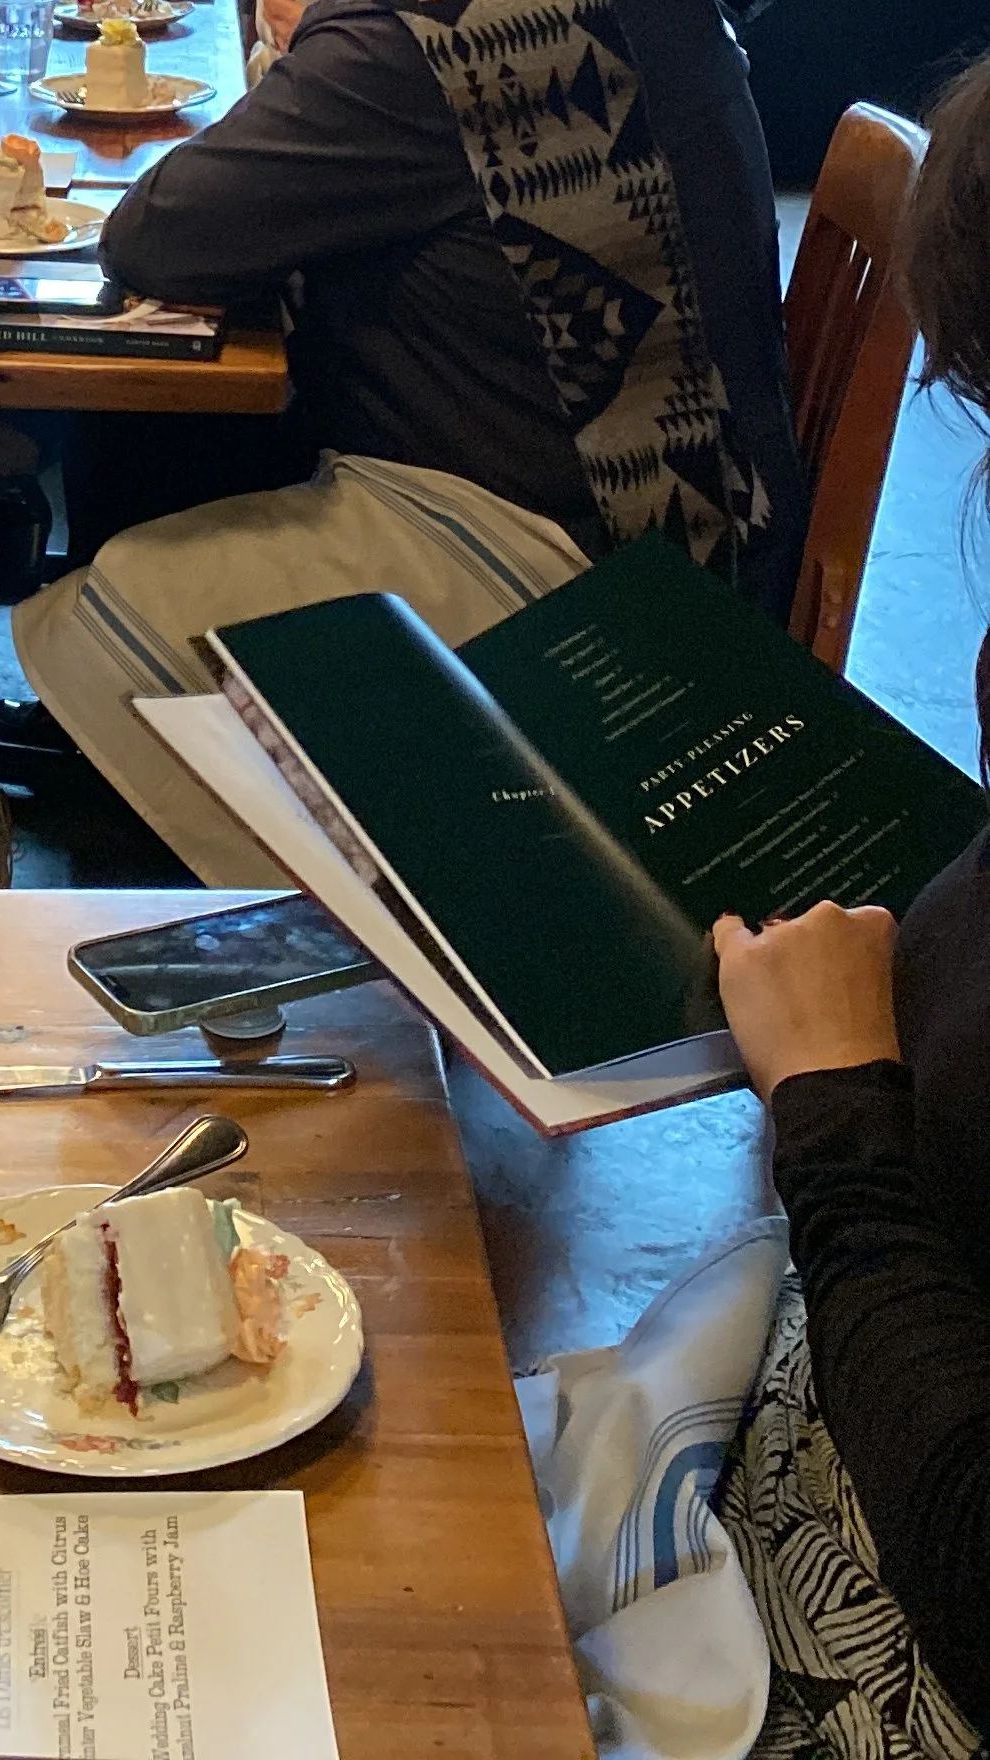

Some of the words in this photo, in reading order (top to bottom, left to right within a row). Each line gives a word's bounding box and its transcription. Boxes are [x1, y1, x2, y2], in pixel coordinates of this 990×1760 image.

[16, 331, 47, 342] HILL
[687, 713, 754, 761] PLEASING
[644, 714, 806, 835] APPETIZERS
[491, 789, 544, 802] Chapter
[50, 1516, 67, 1566] Citrus
[72, 1515, 89, 1556] Cake
[140, 1529, 158, 1568] with
[163, 1515, 180, 1549] Jam
[50, 1570, 68, 1608] with
[73, 1560, 90, 1591] Hoe
[142, 1571, 160, 1617] Fours
[166, 1553, 187, 1636] Raspberry
[74, 1595, 91, 1606] &
[51, 1612, 69, 1666] Catfish
[75, 1609, 92, 1648] Slaw
[145, 1621, 163, 1658] Petit
[170, 1640, 186, 1651] &
[123, 1626, 141, 1680] Dessert
[53, 1670, 70, 1710] Fried
[76, 1651, 98, 1723] Vegetable
[148, 1661, 166, 1698] Cake
[171, 1655, 191, 1711] Praline
[79, 1726, 95, 1759] inter
